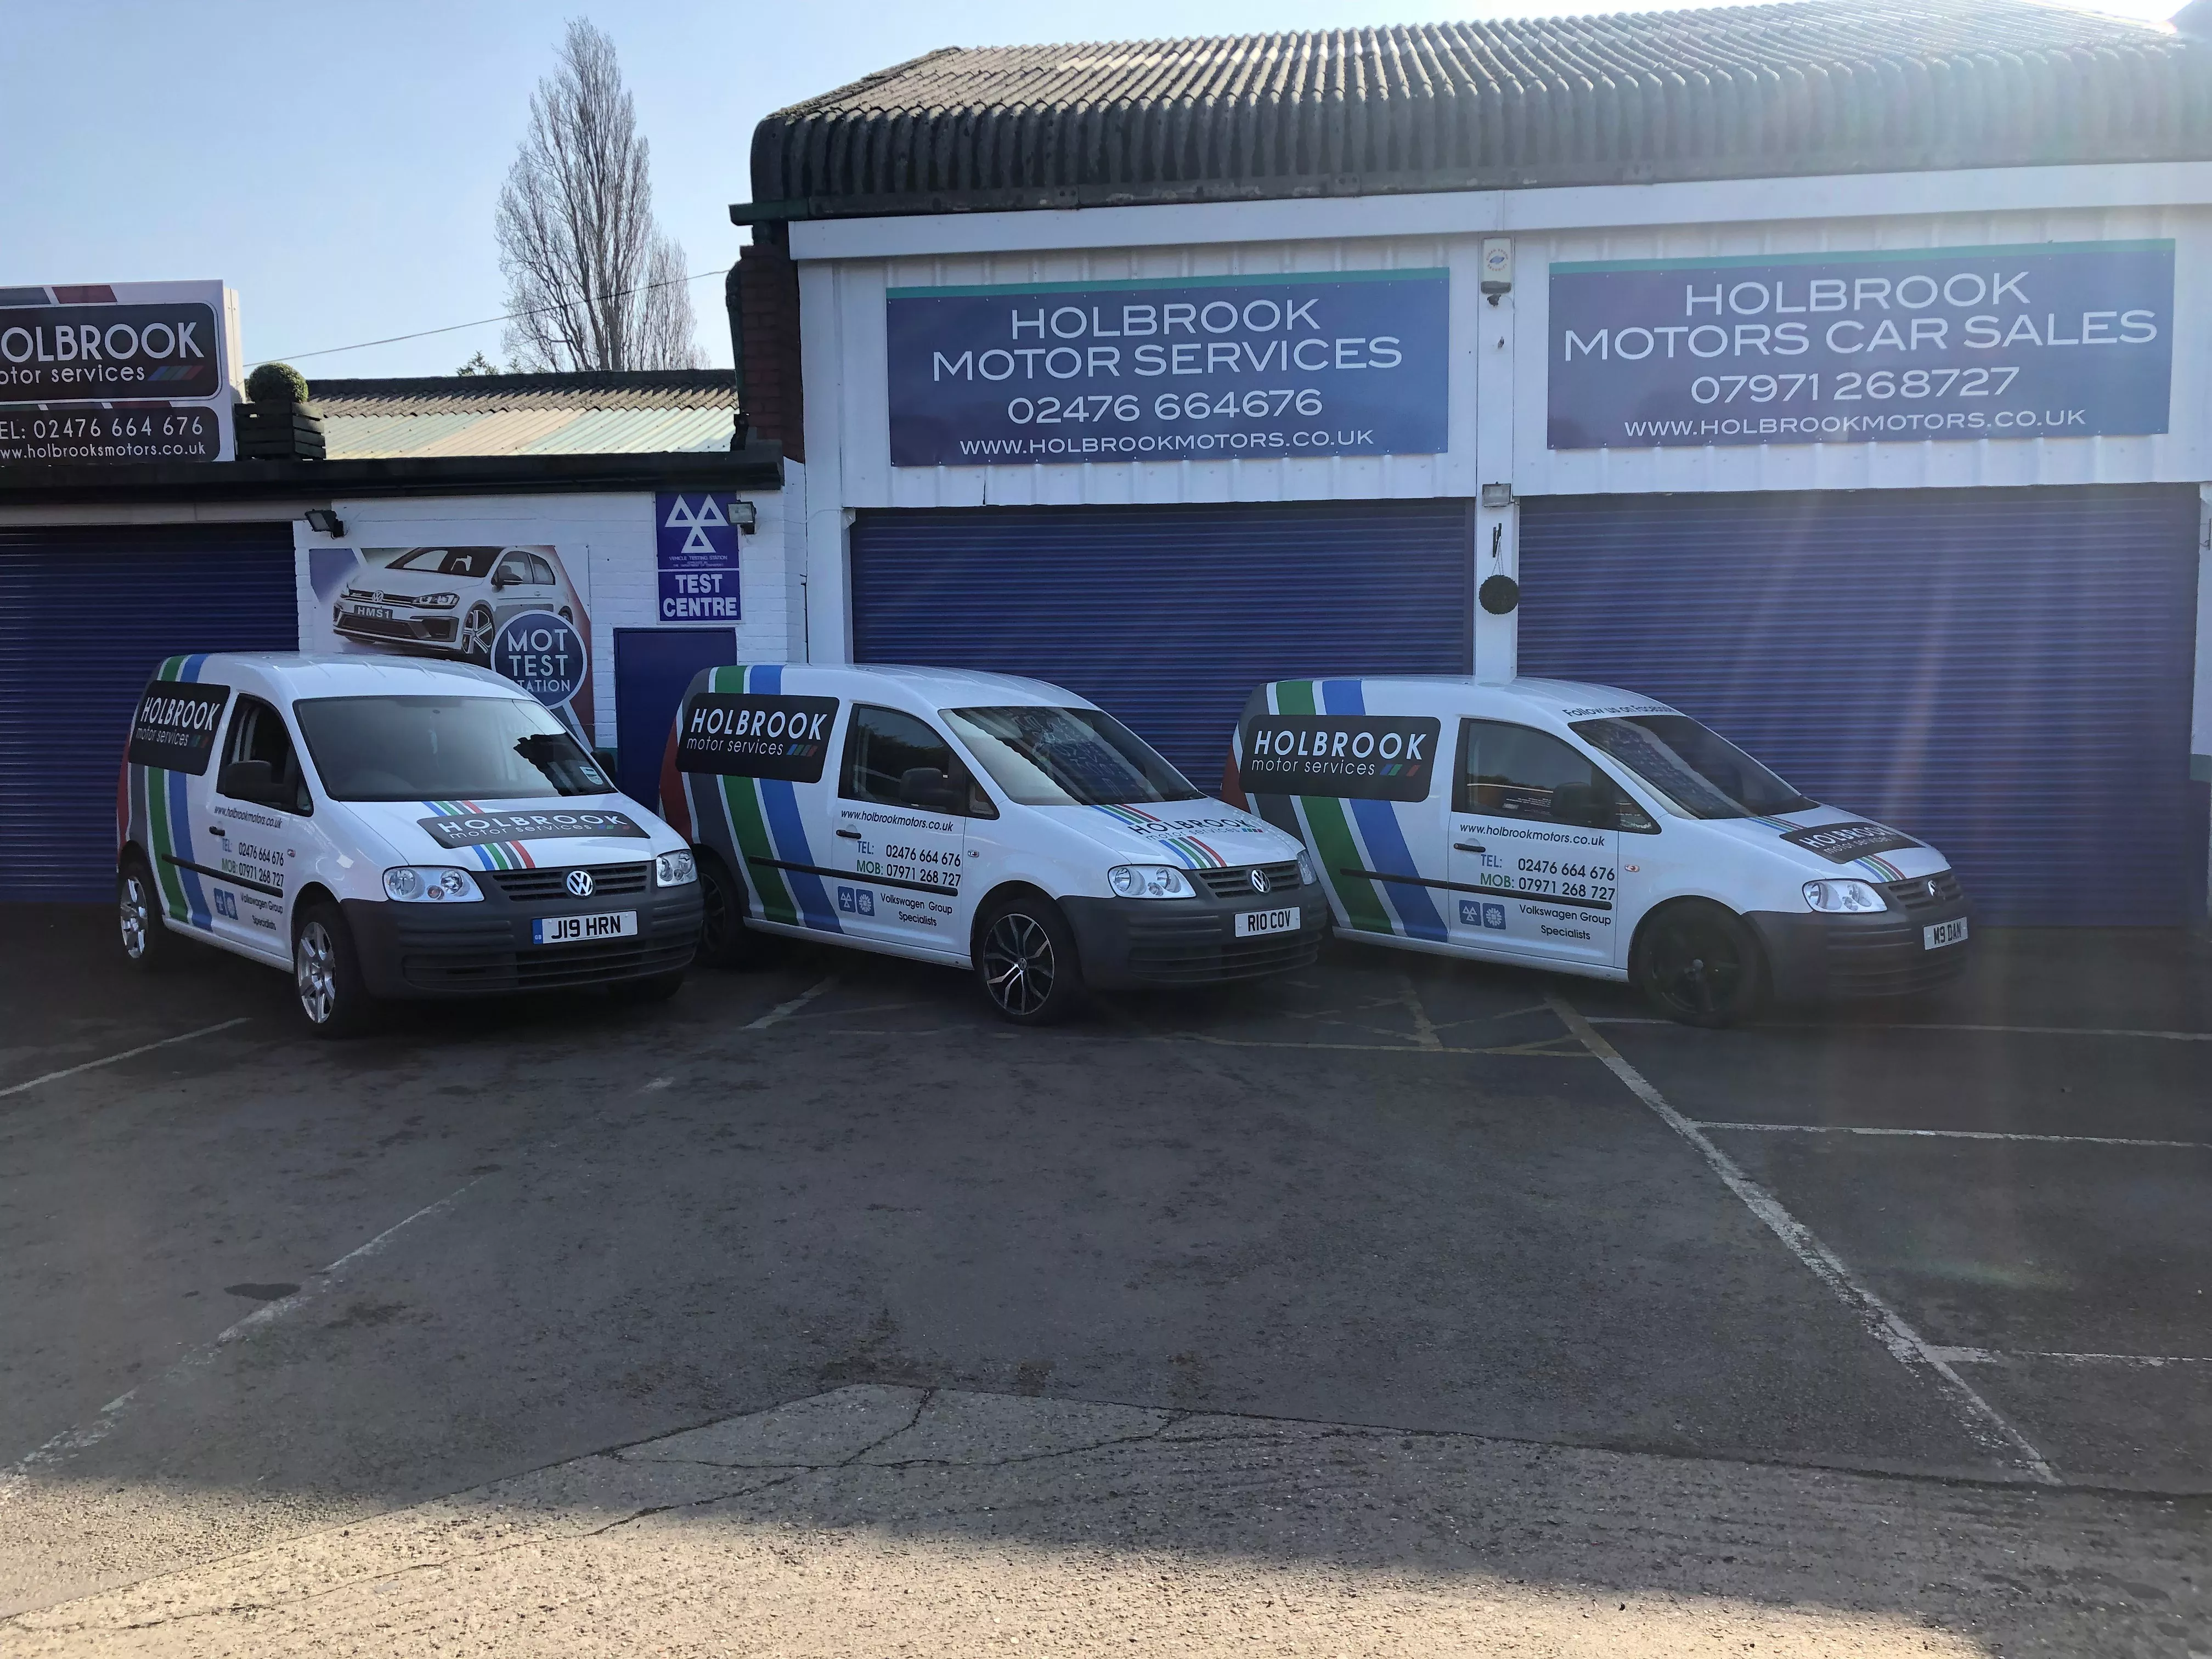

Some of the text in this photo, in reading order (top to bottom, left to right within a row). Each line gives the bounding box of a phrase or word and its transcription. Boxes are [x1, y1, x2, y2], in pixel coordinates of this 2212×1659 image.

[1686, 272, 2030, 316] HOLBROOK
[1012, 298, 1321, 340] HOLBROOK
[1, 322, 204, 363] OLBROOK
[1565, 309, 2157, 362] MOTORS CAR SALES
[933, 336, 1402, 382] MOTOR SERVICES
[0, 364, 145, 385] otor services
[1691, 366, 2020, 403] 07971 268727
[1008, 388, 1323, 424] 02476 664676
[0, 415, 203, 439] EL: 02476 664 676
[1624, 409, 2086, 437] WWW.HOLBROOKMOTORS.CO.UK
[0, 442, 206, 459] ww.holbrooksmotors.co.uk
[960, 430, 1374, 455] WWW.HOLBROOKMOTORS.CO.UK
[675, 574, 723, 593] TEST
[663, 597, 737, 617] CENTRE
[507, 629, 568, 652] MOT
[509, 655, 568, 676] TEST
[516, 679, 571, 692] TATION
[140, 697, 220, 731] HOLBROOK
[1561, 708, 1605, 717] Follow
[136, 725, 189, 747] motor services
[691, 708, 828, 741] HOLBROOK
[686, 736, 784, 755] motor services
[1254, 730, 1427, 760] HOLBROOK
[1251, 757, 1375, 776] motor services
[437, 814, 628, 833] HOLBROOK
[449, 823, 592, 839] motor services
[841, 810, 953, 832] www.holbrookmotors.co.uk
[1127, 819, 1257, 835] HOLBROOK
[1146, 831, 1186, 841] motor
[1460, 824, 1605, 847] www.holbrookmotors.co.uk
[222, 838, 284, 866] TEL: 02476 664 676
[857, 840, 961, 867] TEL: 02476 664 676
[1823, 842, 1855, 854] motor
[221, 857, 284, 887] MOB: 07971 268 727
[856, 859, 961, 887] MOB: 07971 268 727
[1481, 854, 1615, 881] TEL: 02476 664 676
[1480, 873, 1616, 901] MOB: 07971 268 727
[880, 893, 953, 916] Volkswagen Group
[1519, 904, 1611, 927] Volkswagen Group
[551, 915, 621, 939] J19 HRN
[898, 911, 938, 927] Specialists
[1248, 910, 1291, 932] R10 COV
[1541, 925, 1591, 940] Specialists
